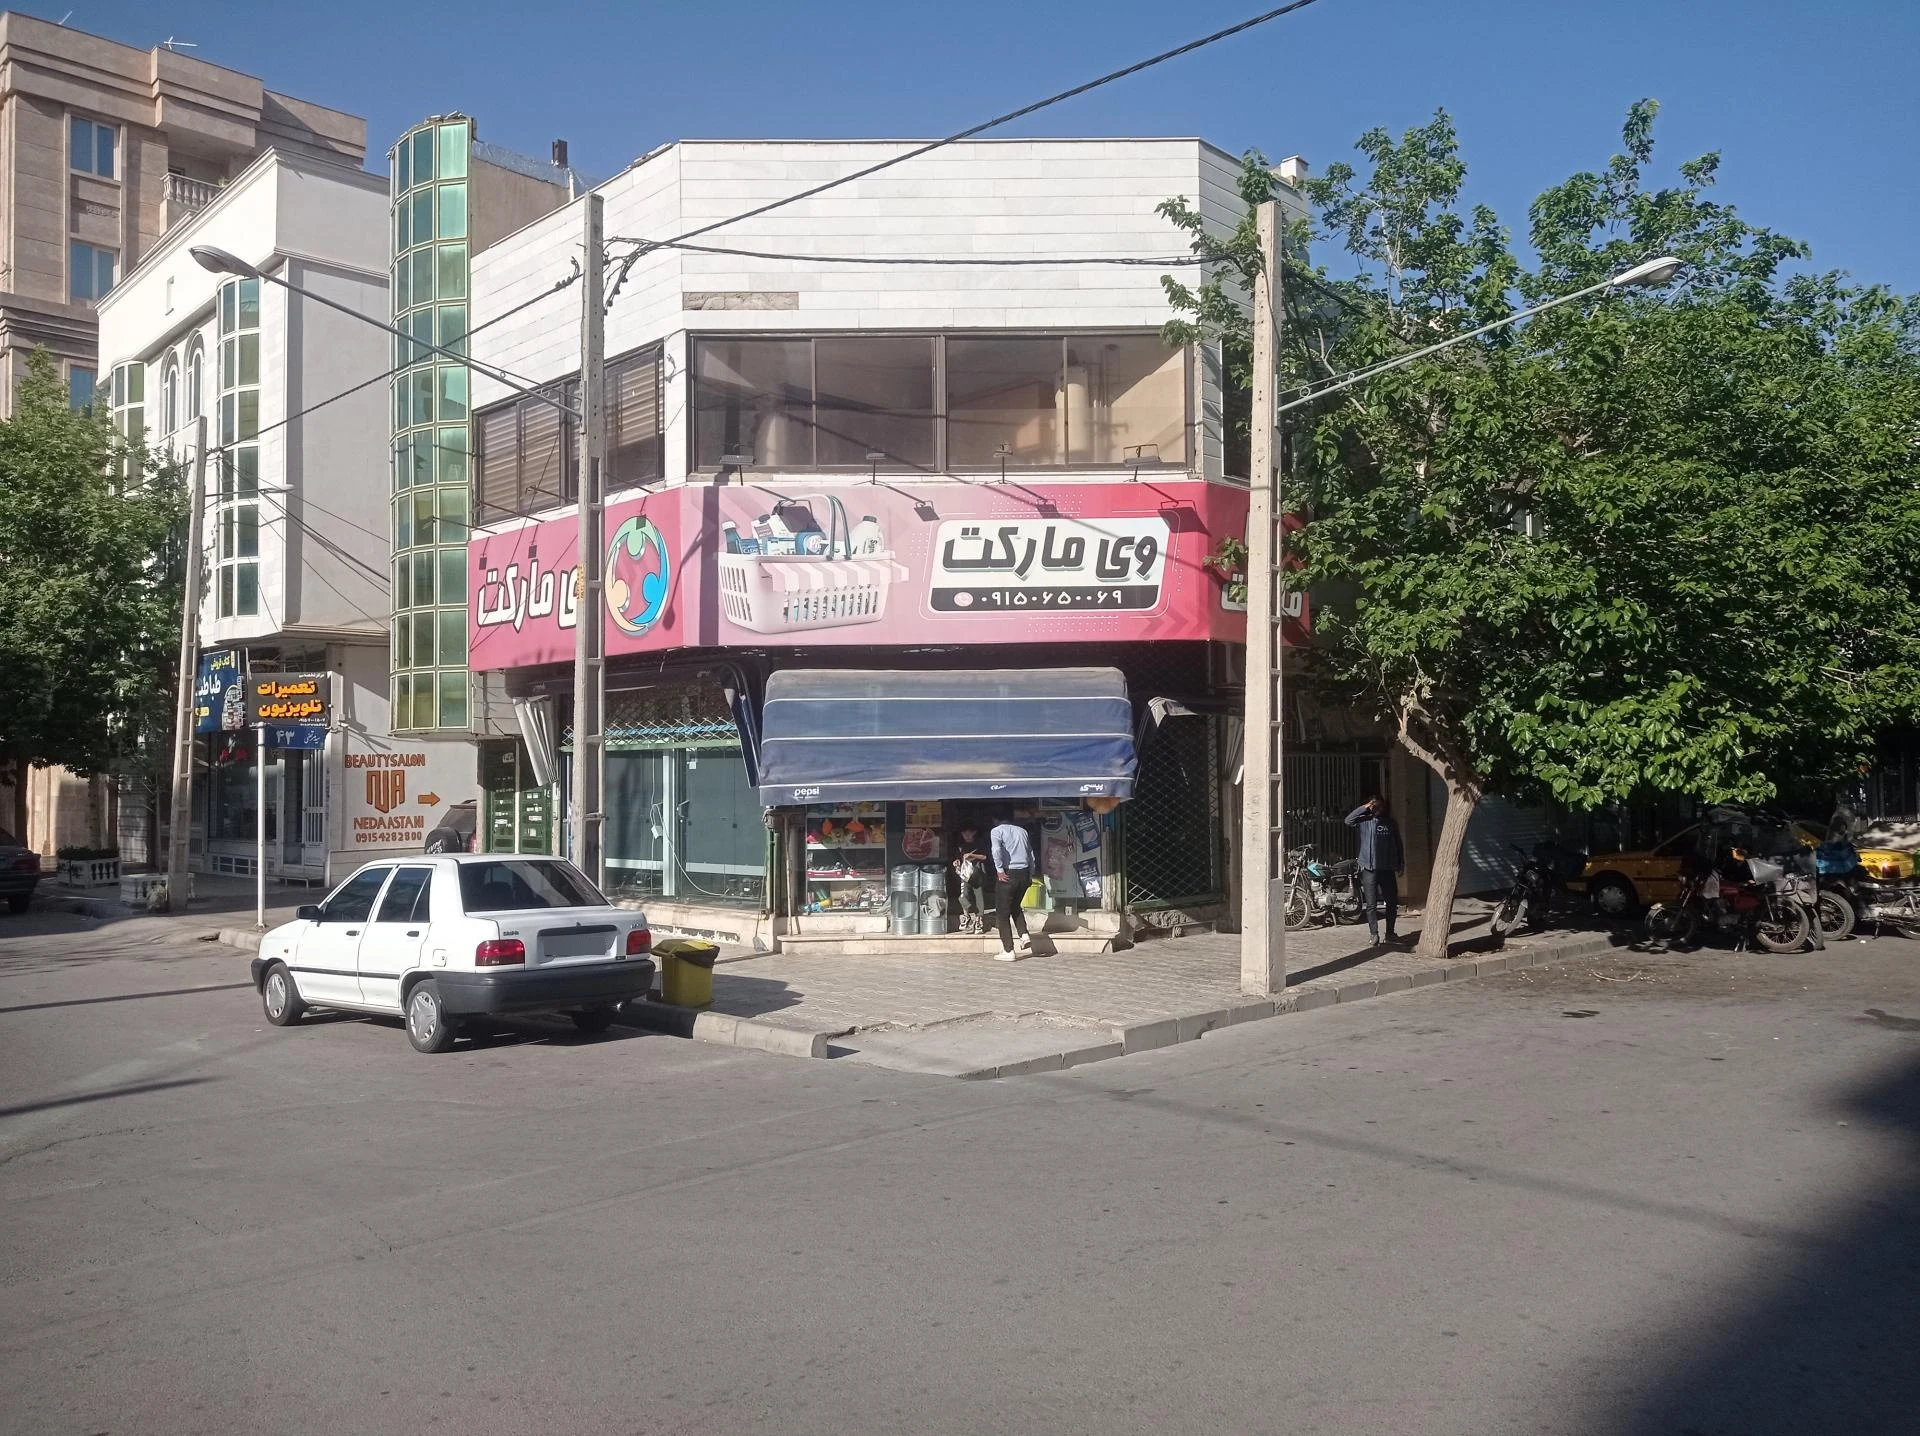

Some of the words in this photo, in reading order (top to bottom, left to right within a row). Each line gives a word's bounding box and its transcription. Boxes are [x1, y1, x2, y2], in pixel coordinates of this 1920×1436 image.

[942, 526, 1086, 581] مارکت
[1095, 535, 1159, 582] وی
[477, 558, 556, 634] مارکت
[257, 680, 318, 698] تعمیرات
[258, 699, 324, 718] تلویزیون
[275, 730, 296, 746] ۴۳
[794, 786, 820, 797] pepsi
